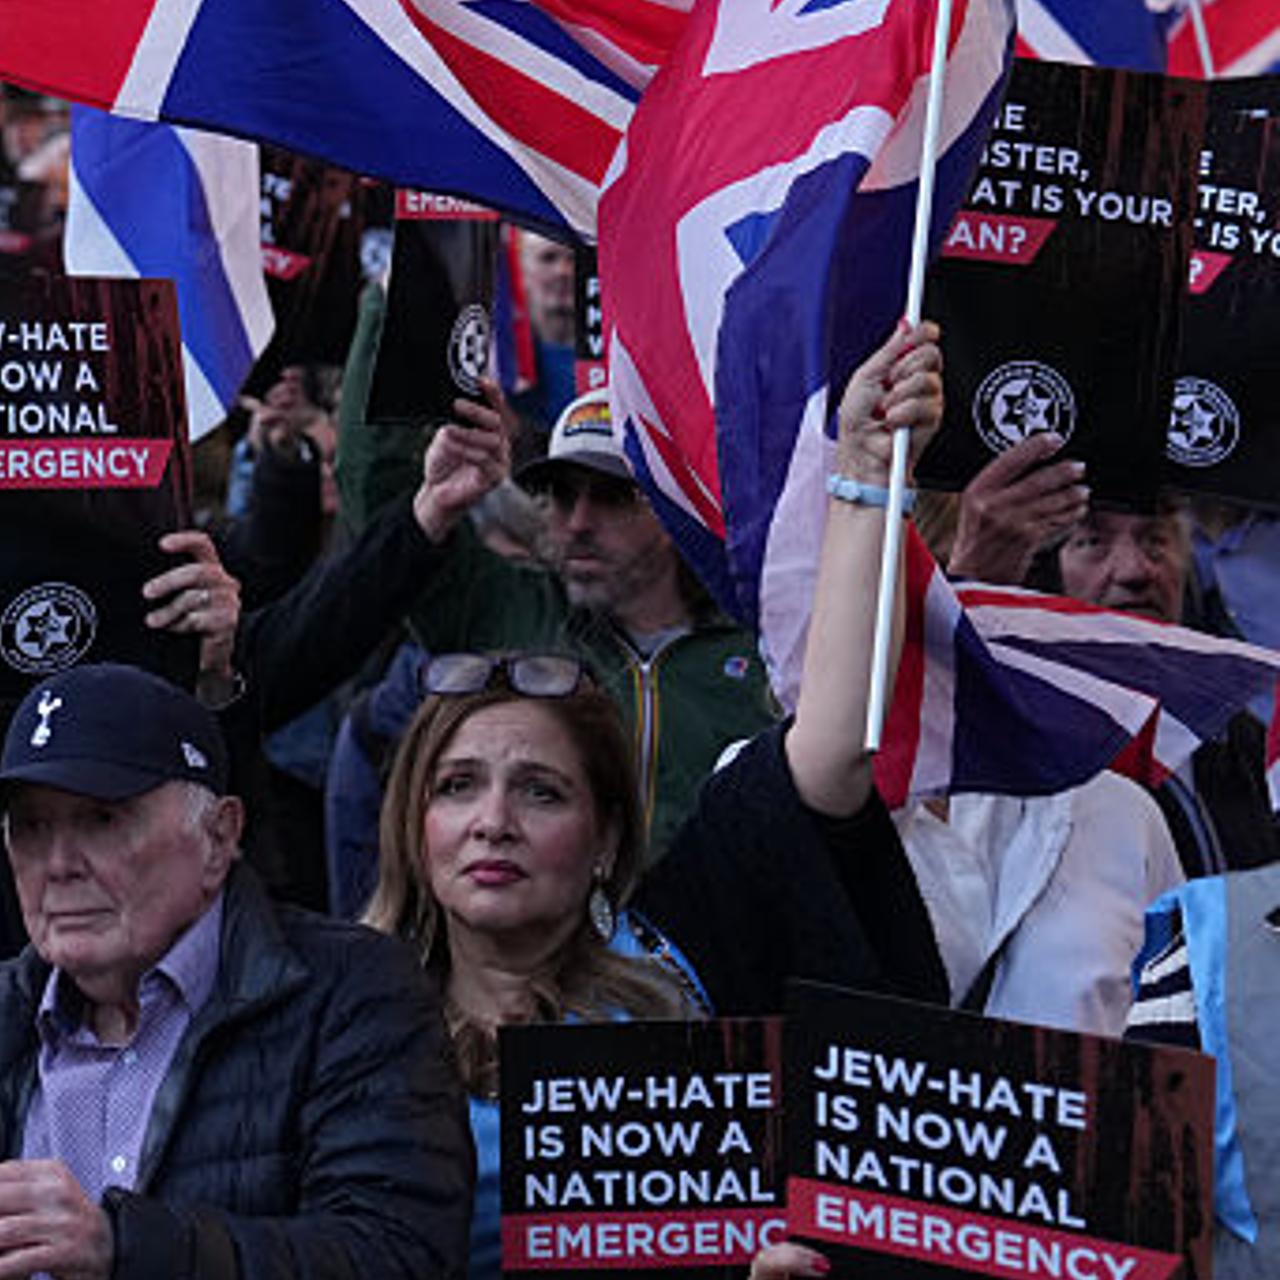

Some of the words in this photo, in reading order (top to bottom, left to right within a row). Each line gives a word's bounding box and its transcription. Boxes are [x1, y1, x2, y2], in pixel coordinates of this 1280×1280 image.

[987, 140, 1090, 182] STER,
[972, 177, 1022, 208] AT
[1031, 184, 1064, 213] IS
[1074, 189, 1174, 228] YOUR
[948, 221, 1027, 254] AN?
[75, 363, 98, 391] A
[522, 1072, 773, 1114] JEW-HATE
[814, 1046, 1087, 1130] JEW-HATE
[525, 1124, 565, 1160] IS
[581, 1121, 705, 1157] NOW
[718, 1120, 752, 1154] A
[817, 1091, 858, 1131] IS
[877, 1098, 1007, 1161] NOW
[1023, 1135, 1061, 1173] A
[525, 1169, 775, 1206] NATIONAL
[815, 1142, 1086, 1228] NATIONAL
[528, 1219, 786, 1257] EMERGENC
[816, 1194, 1137, 1280] EMERGENCY
